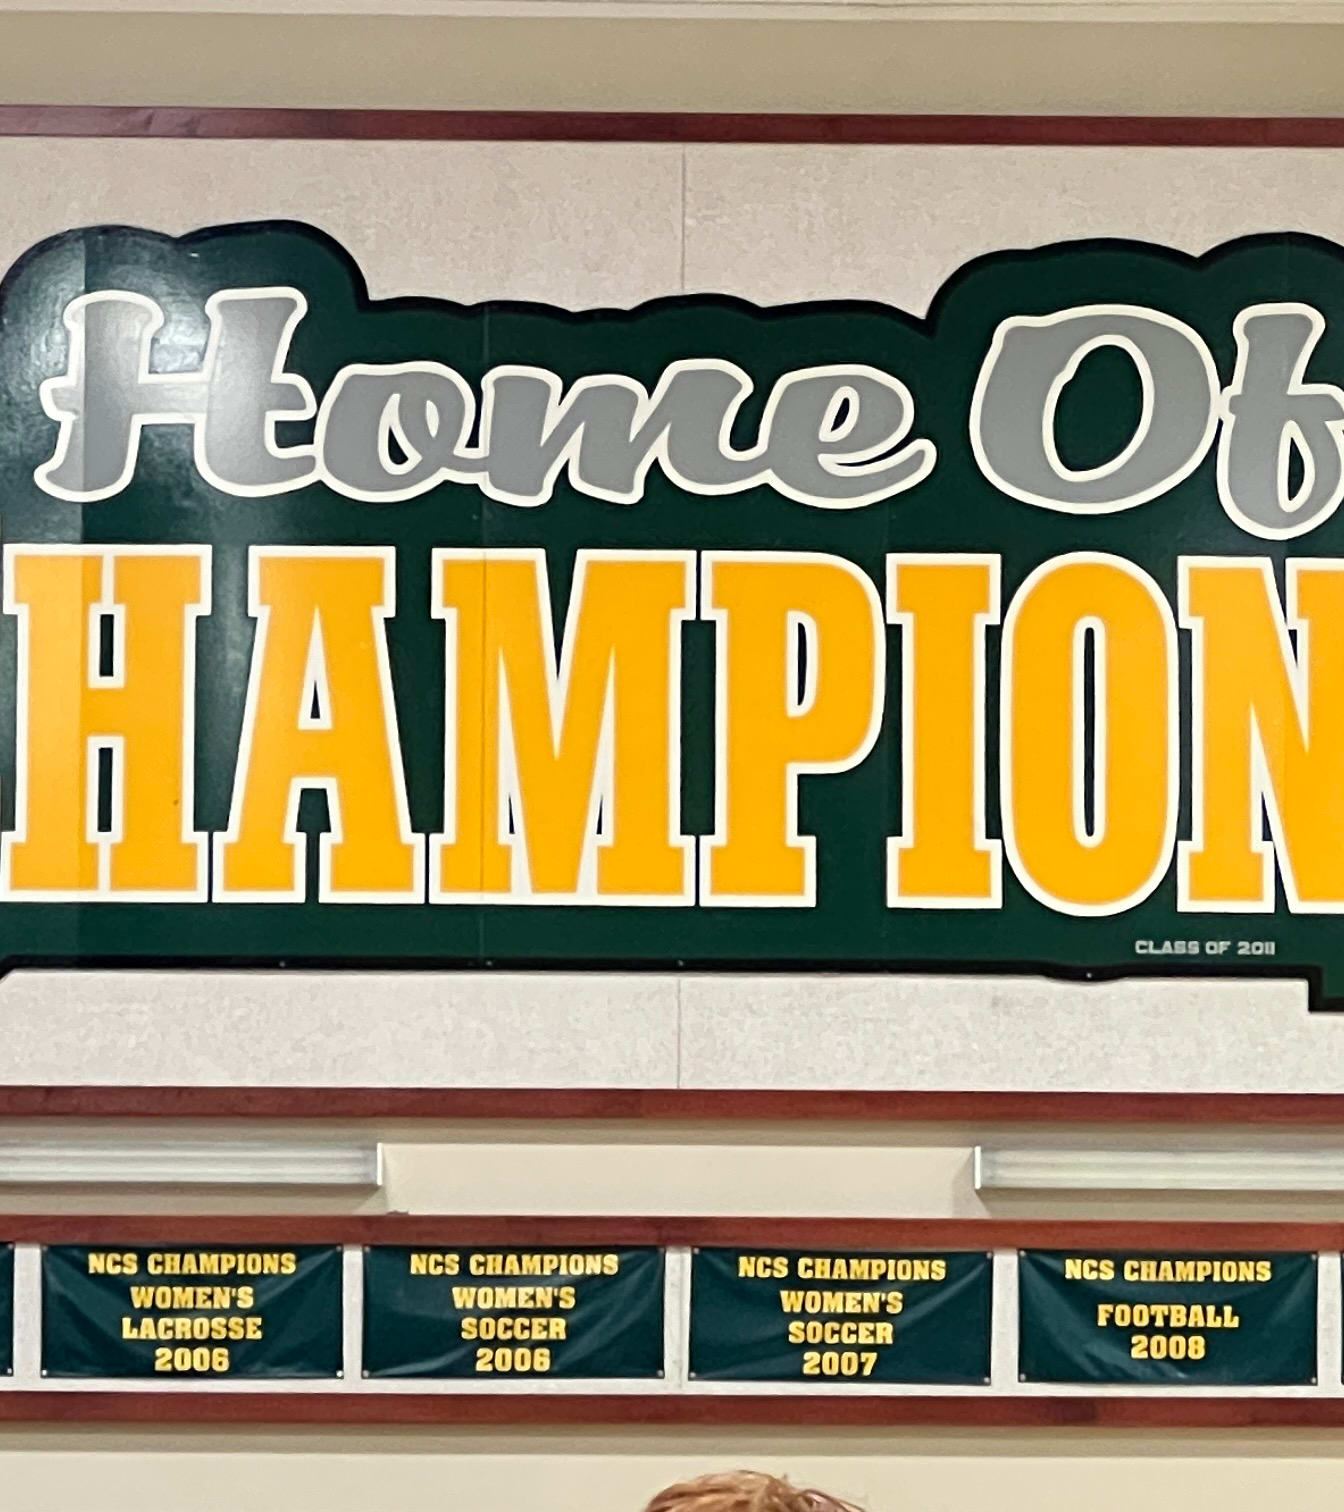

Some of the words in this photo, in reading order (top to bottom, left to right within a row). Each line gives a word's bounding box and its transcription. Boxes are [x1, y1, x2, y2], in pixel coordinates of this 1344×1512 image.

[38, 284, 934, 508] Home
[1135, 940, 1200, 954] CLASS
[1205, 941, 1231, 955] OF
[1237, 941, 1276, 955] 2011
[88, 1252, 138, 1275] NCS
[147, 1252, 297, 1275] CHAMPIONS
[410, 1253, 460, 1276] NCS
[469, 1253, 619, 1276] CHAMPIONS
[738, 1256, 789, 1281] NCS
[797, 1256, 946, 1281] CHAMPIONS
[1064, 1258, 1115, 1283] NCS
[1123, 1258, 1272, 1283] CHAMPIONS
[130, 1285, 254, 1310] WOMEN'S
[452, 1286, 576, 1310] WOMEN'S
[780, 1290, 904, 1314] WOMEN'S
[122, 1316, 263, 1340] LACROSSE
[461, 1316, 567, 1340] SOCCER
[1097, 1303, 1240, 1328] FOOTBALL
[788, 1320, 894, 1345] SOCCER
[154, 1346, 230, 1372] 2006
[475, 1347, 551, 1372] 2006
[1131, 1334, 1206, 1360] 2008
[802, 1351, 878, 1376] 2007
